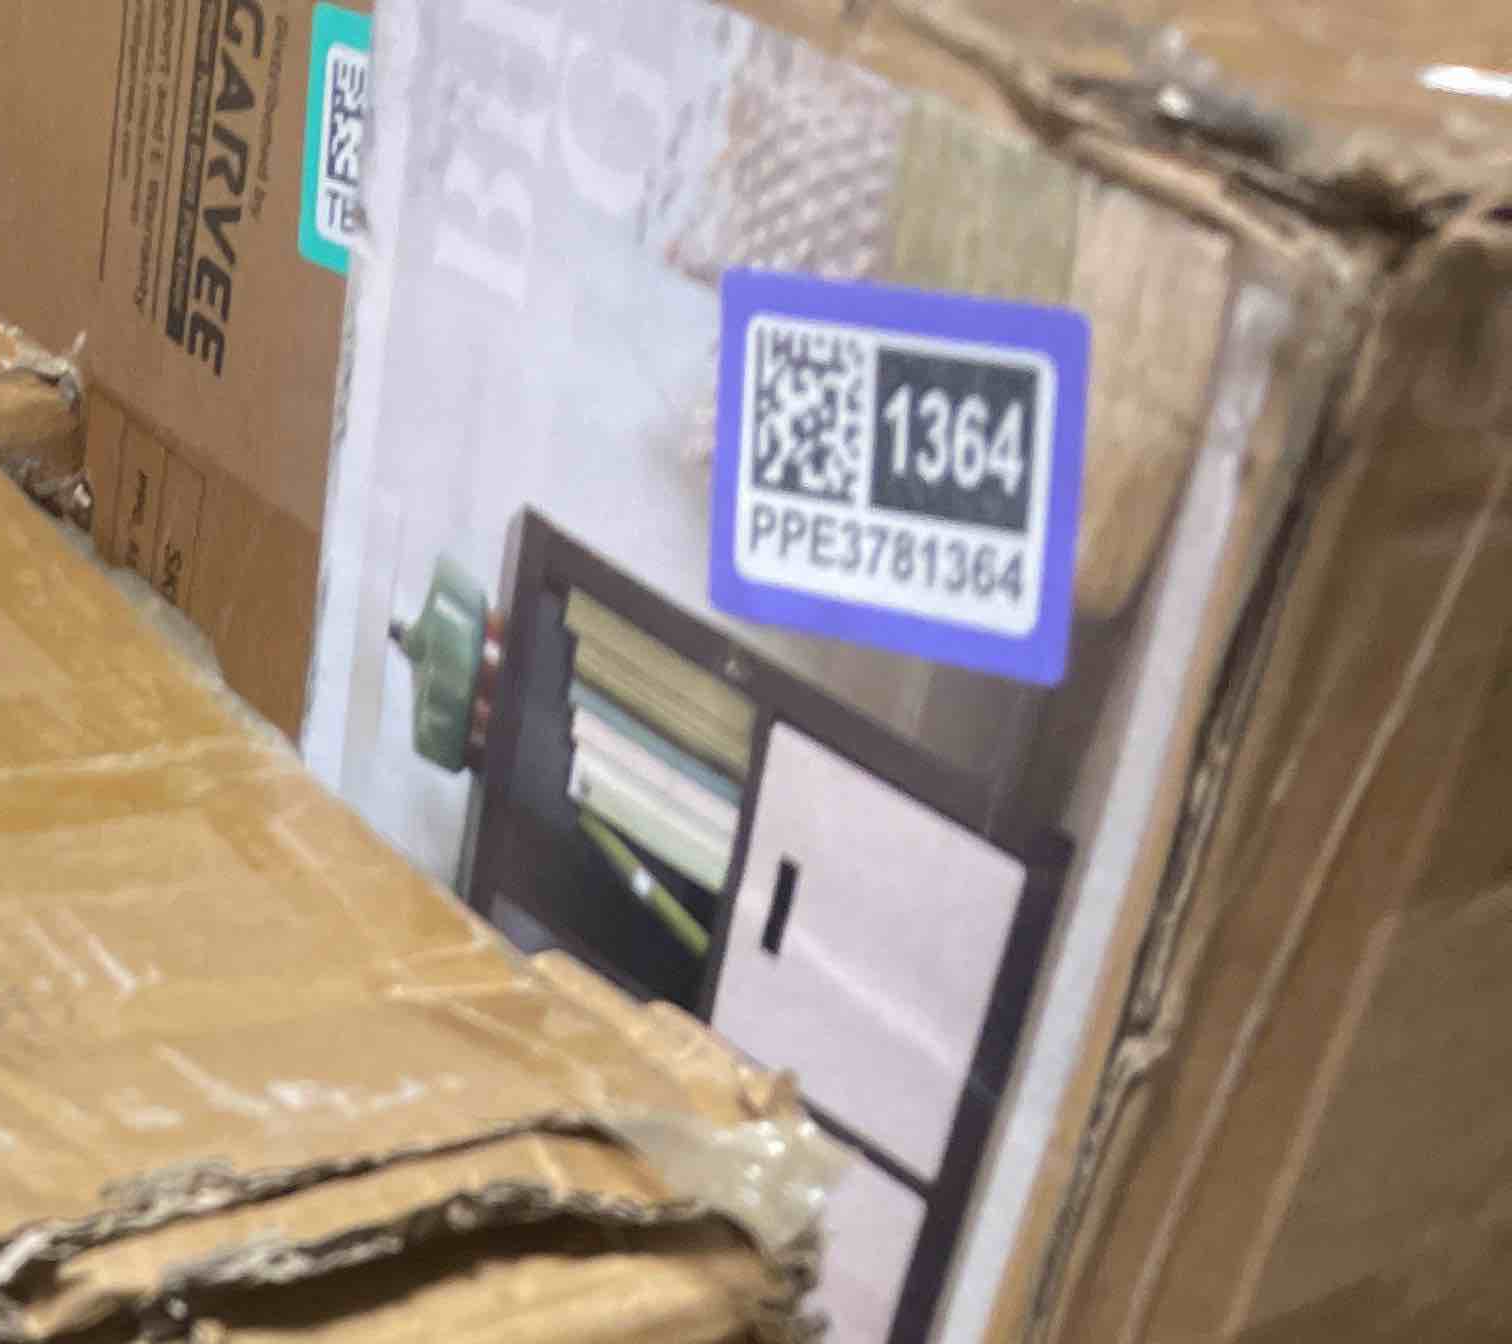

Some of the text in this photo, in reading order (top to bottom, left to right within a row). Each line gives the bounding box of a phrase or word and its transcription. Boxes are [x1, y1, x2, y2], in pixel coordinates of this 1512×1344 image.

[186, 0, 266, 378] GARVEE
[882, 382, 1027, 498] 1364
[748, 503, 1026, 602] PPE3781364
